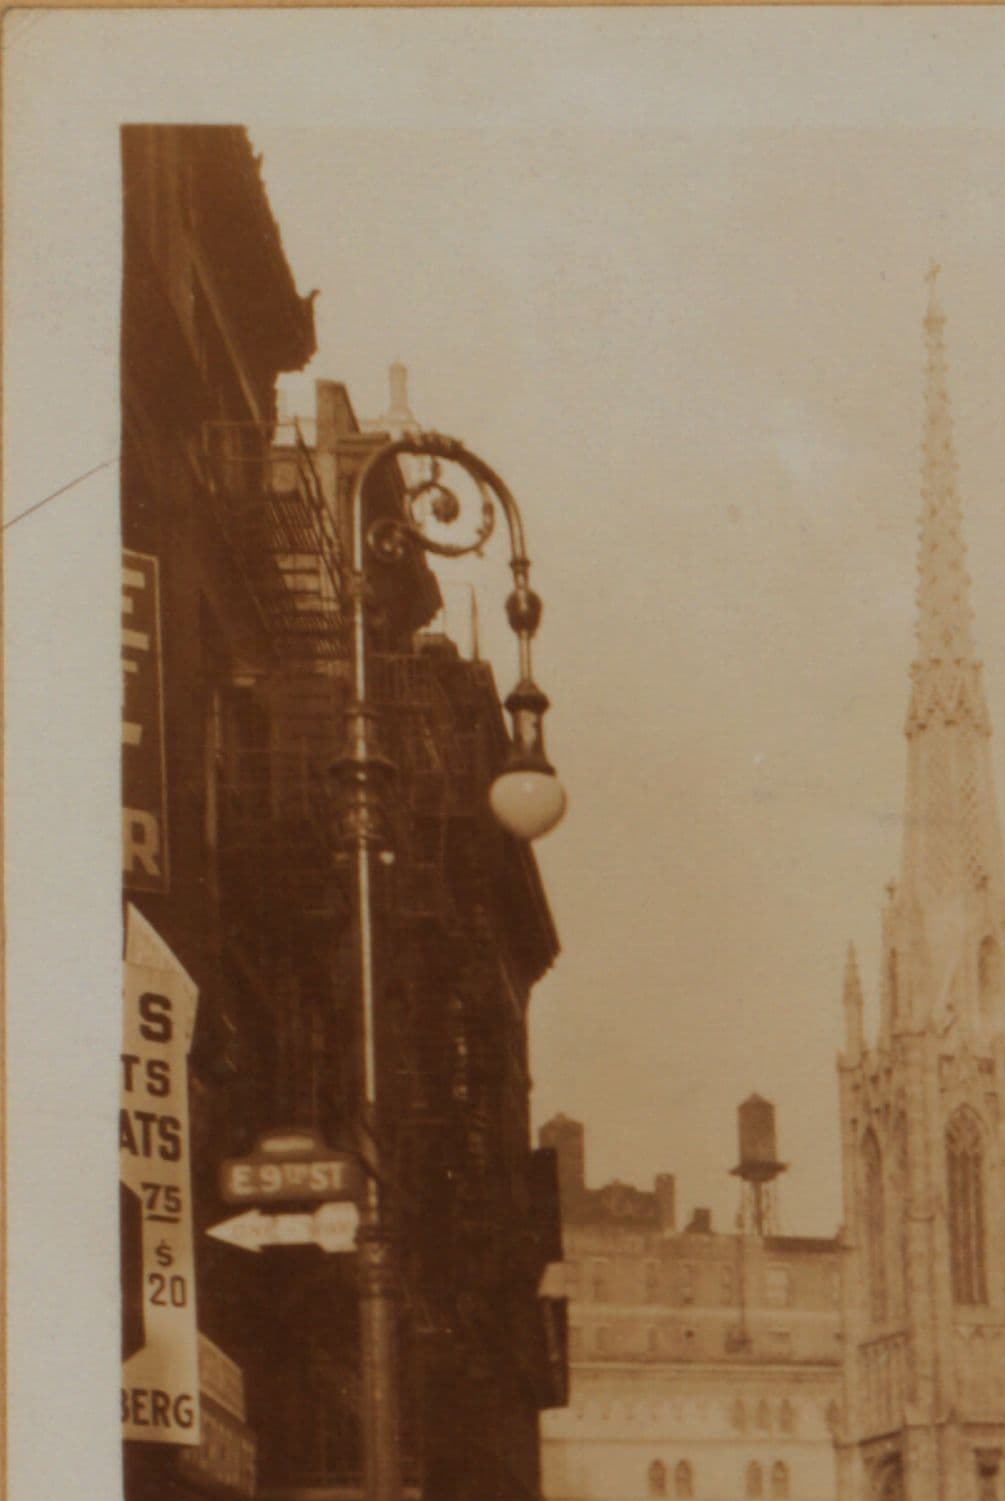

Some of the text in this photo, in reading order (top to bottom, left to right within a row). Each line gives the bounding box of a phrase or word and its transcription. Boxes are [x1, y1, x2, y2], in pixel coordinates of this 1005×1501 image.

[141, 1182, 182, 1213] 75
[155, 1239, 174, 1268] $
[148, 1273, 187, 1308] 20
